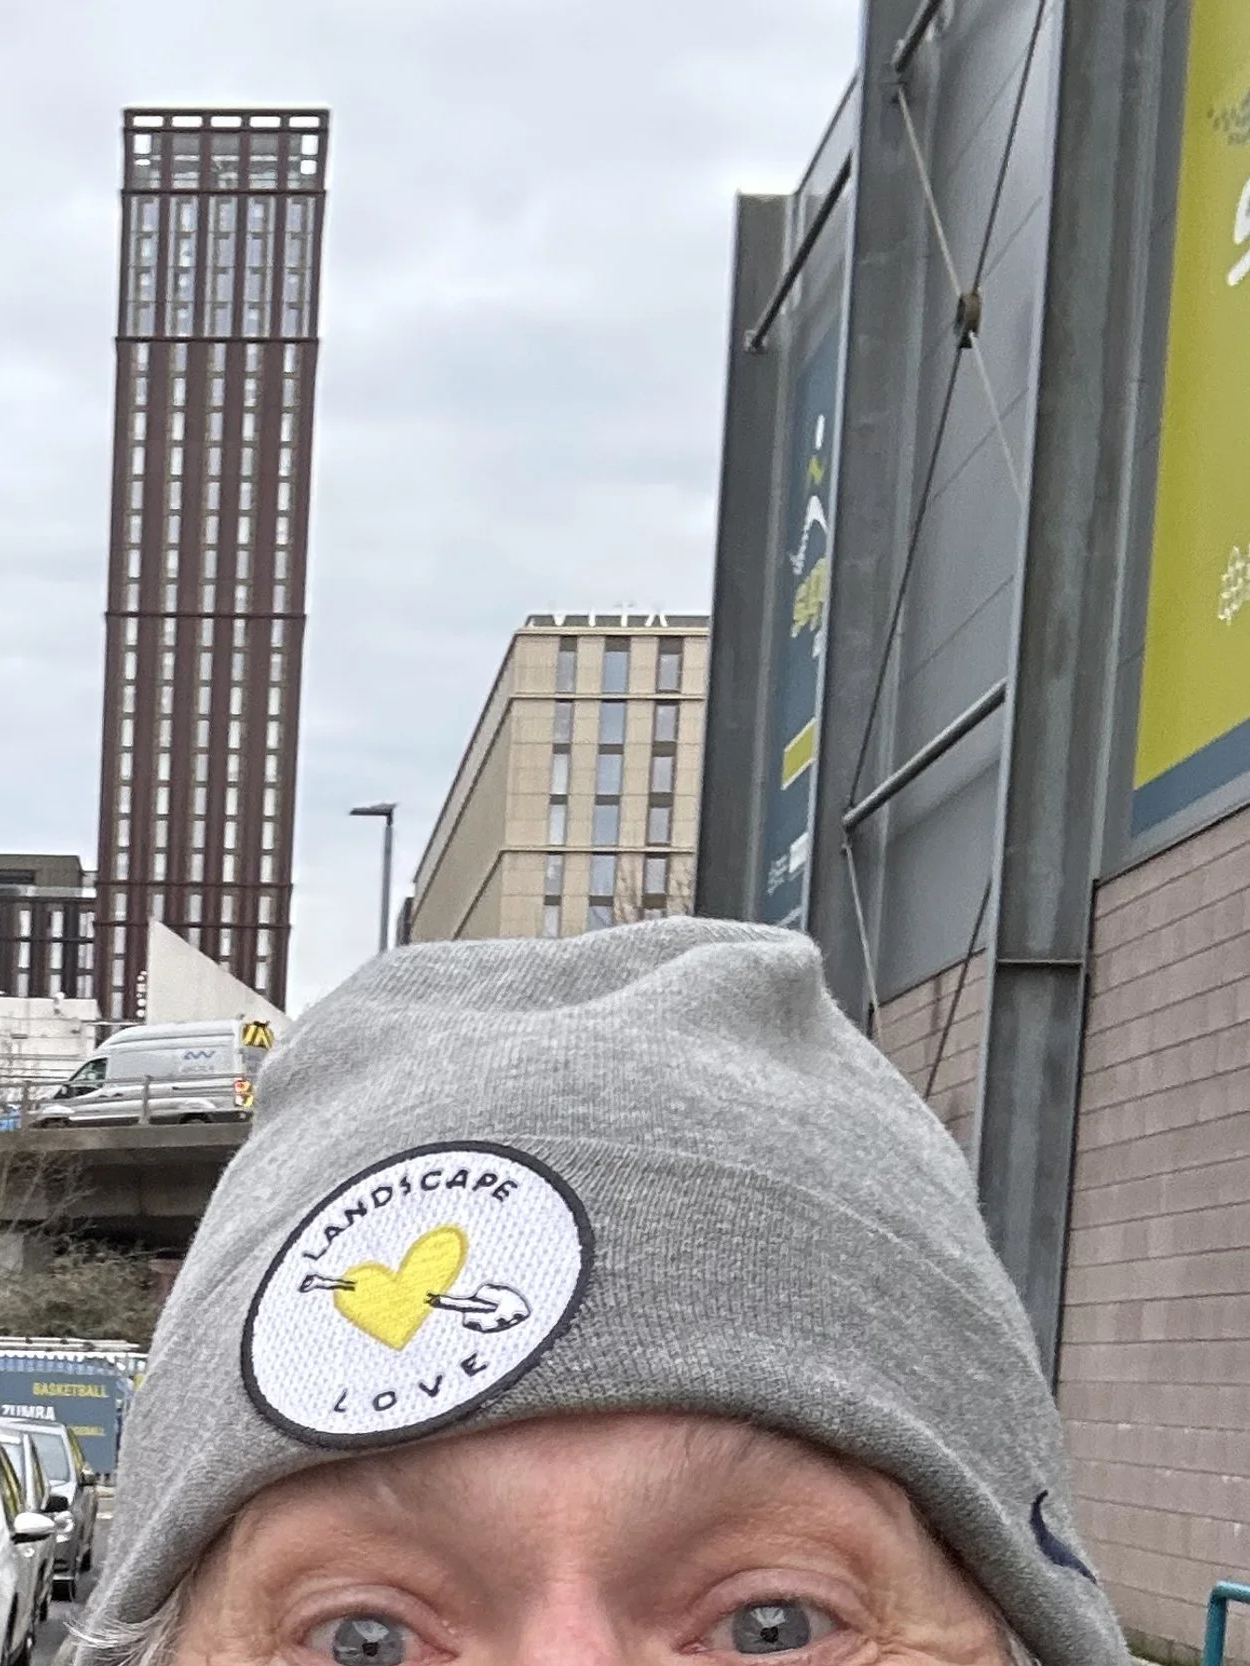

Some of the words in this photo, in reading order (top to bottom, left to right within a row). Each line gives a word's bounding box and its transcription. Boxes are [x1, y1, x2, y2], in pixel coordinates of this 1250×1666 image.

[303, 1169, 518, 1261] LANDSCAPE
[32, 1382, 109, 1398] BASKETBALL
[334, 1354, 488, 1412] LOVE
